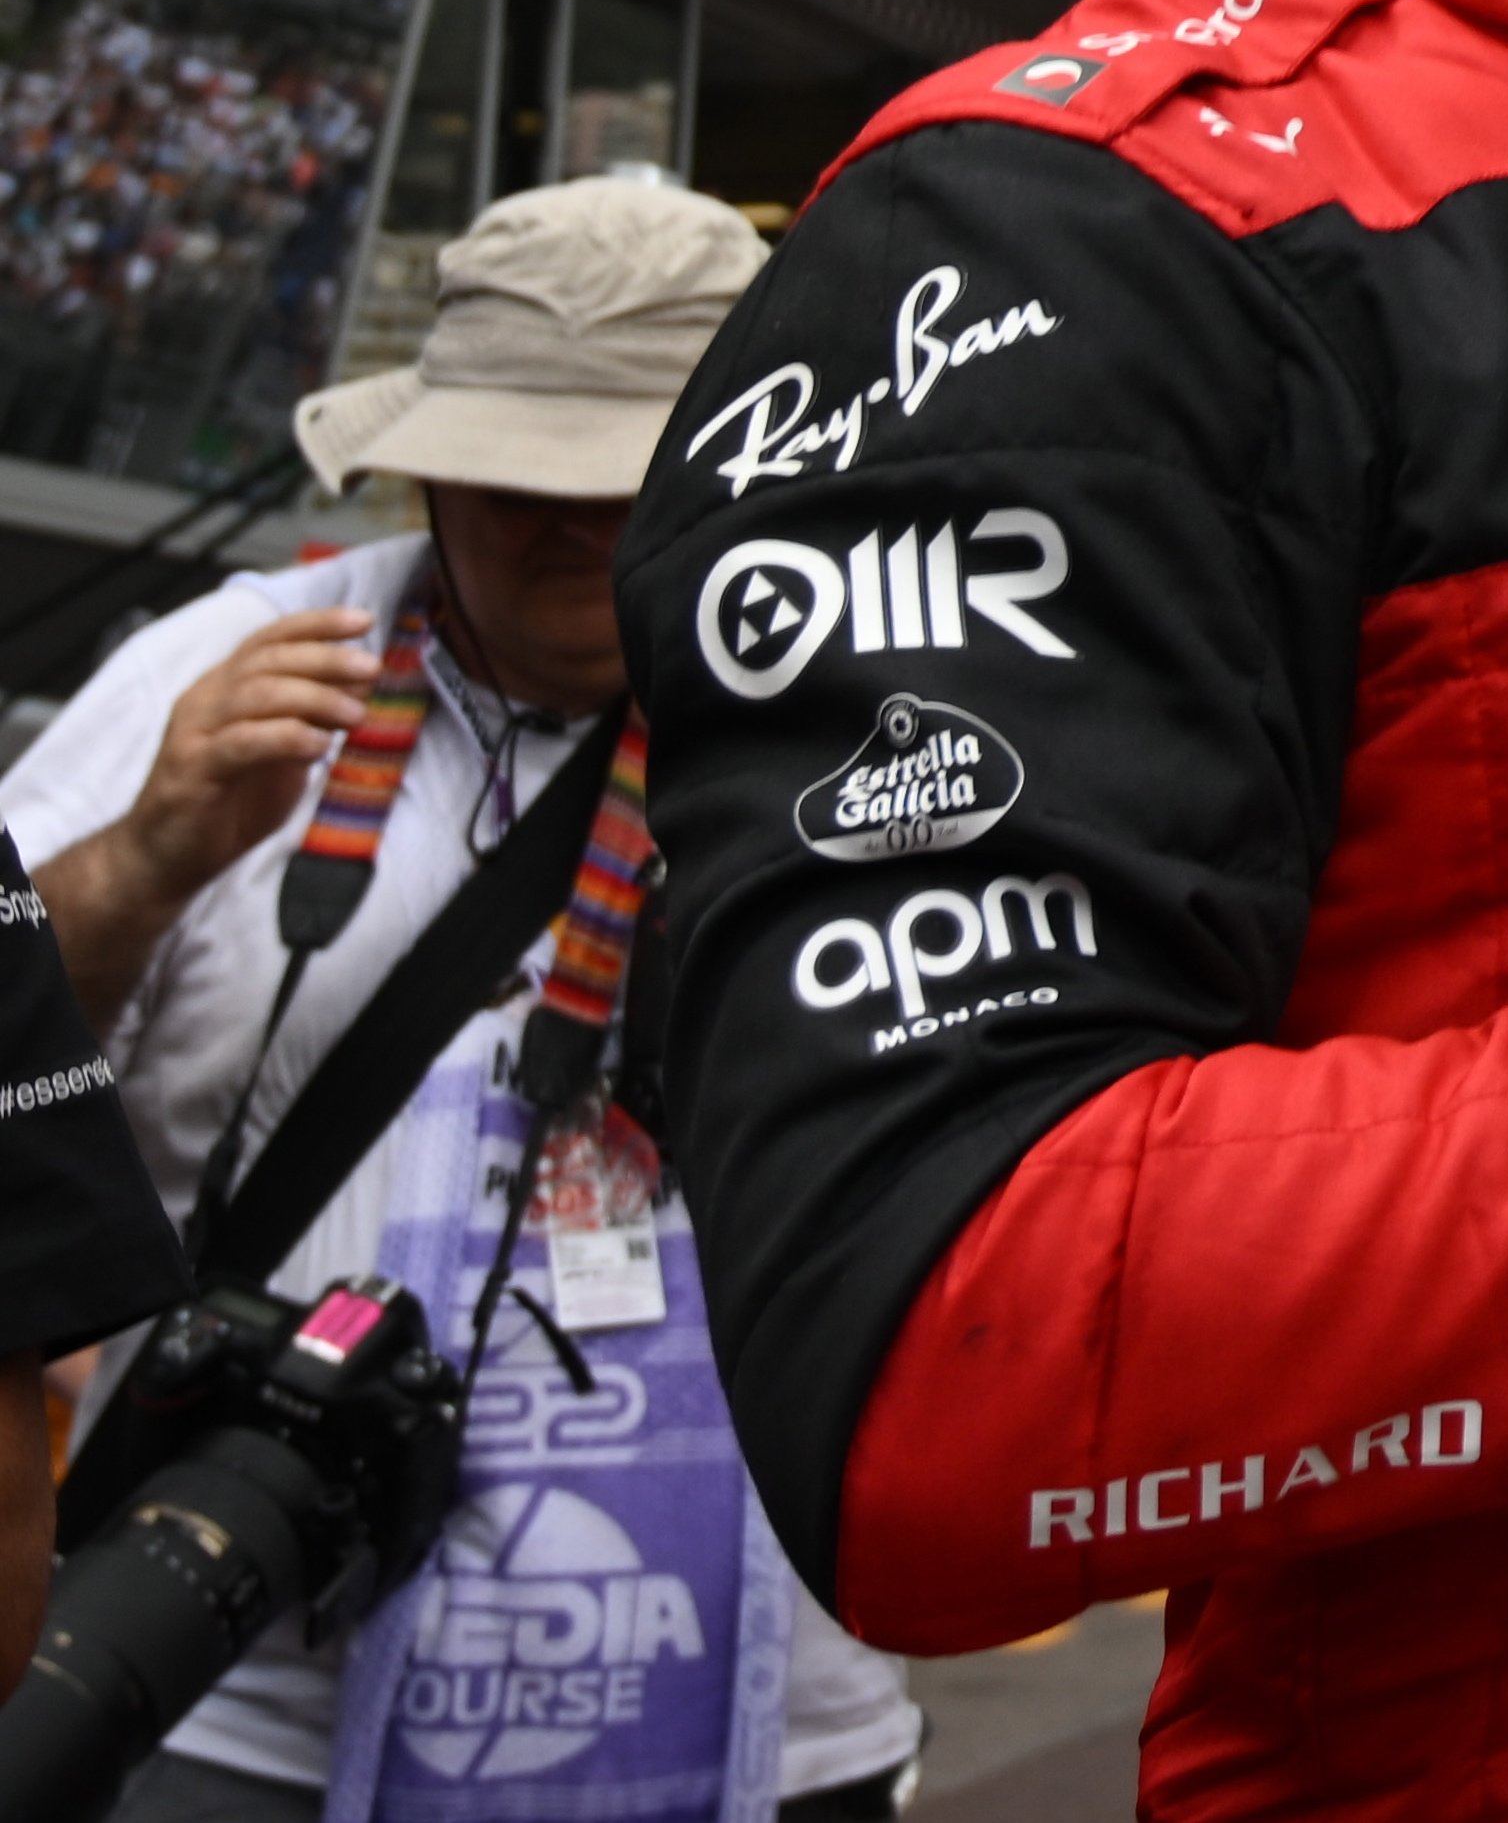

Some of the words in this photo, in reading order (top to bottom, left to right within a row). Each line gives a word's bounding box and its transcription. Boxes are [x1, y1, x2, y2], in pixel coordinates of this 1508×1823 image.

[837, 728, 983, 798] Estrella
[834, 769, 978, 830] Galicia
[790, 874, 1100, 1022] apm
[872, 986, 1062, 1056] MONACO
[1028, 1399, 1487, 1551] RICHARD
[394, 1668, 647, 1726] OURSE
